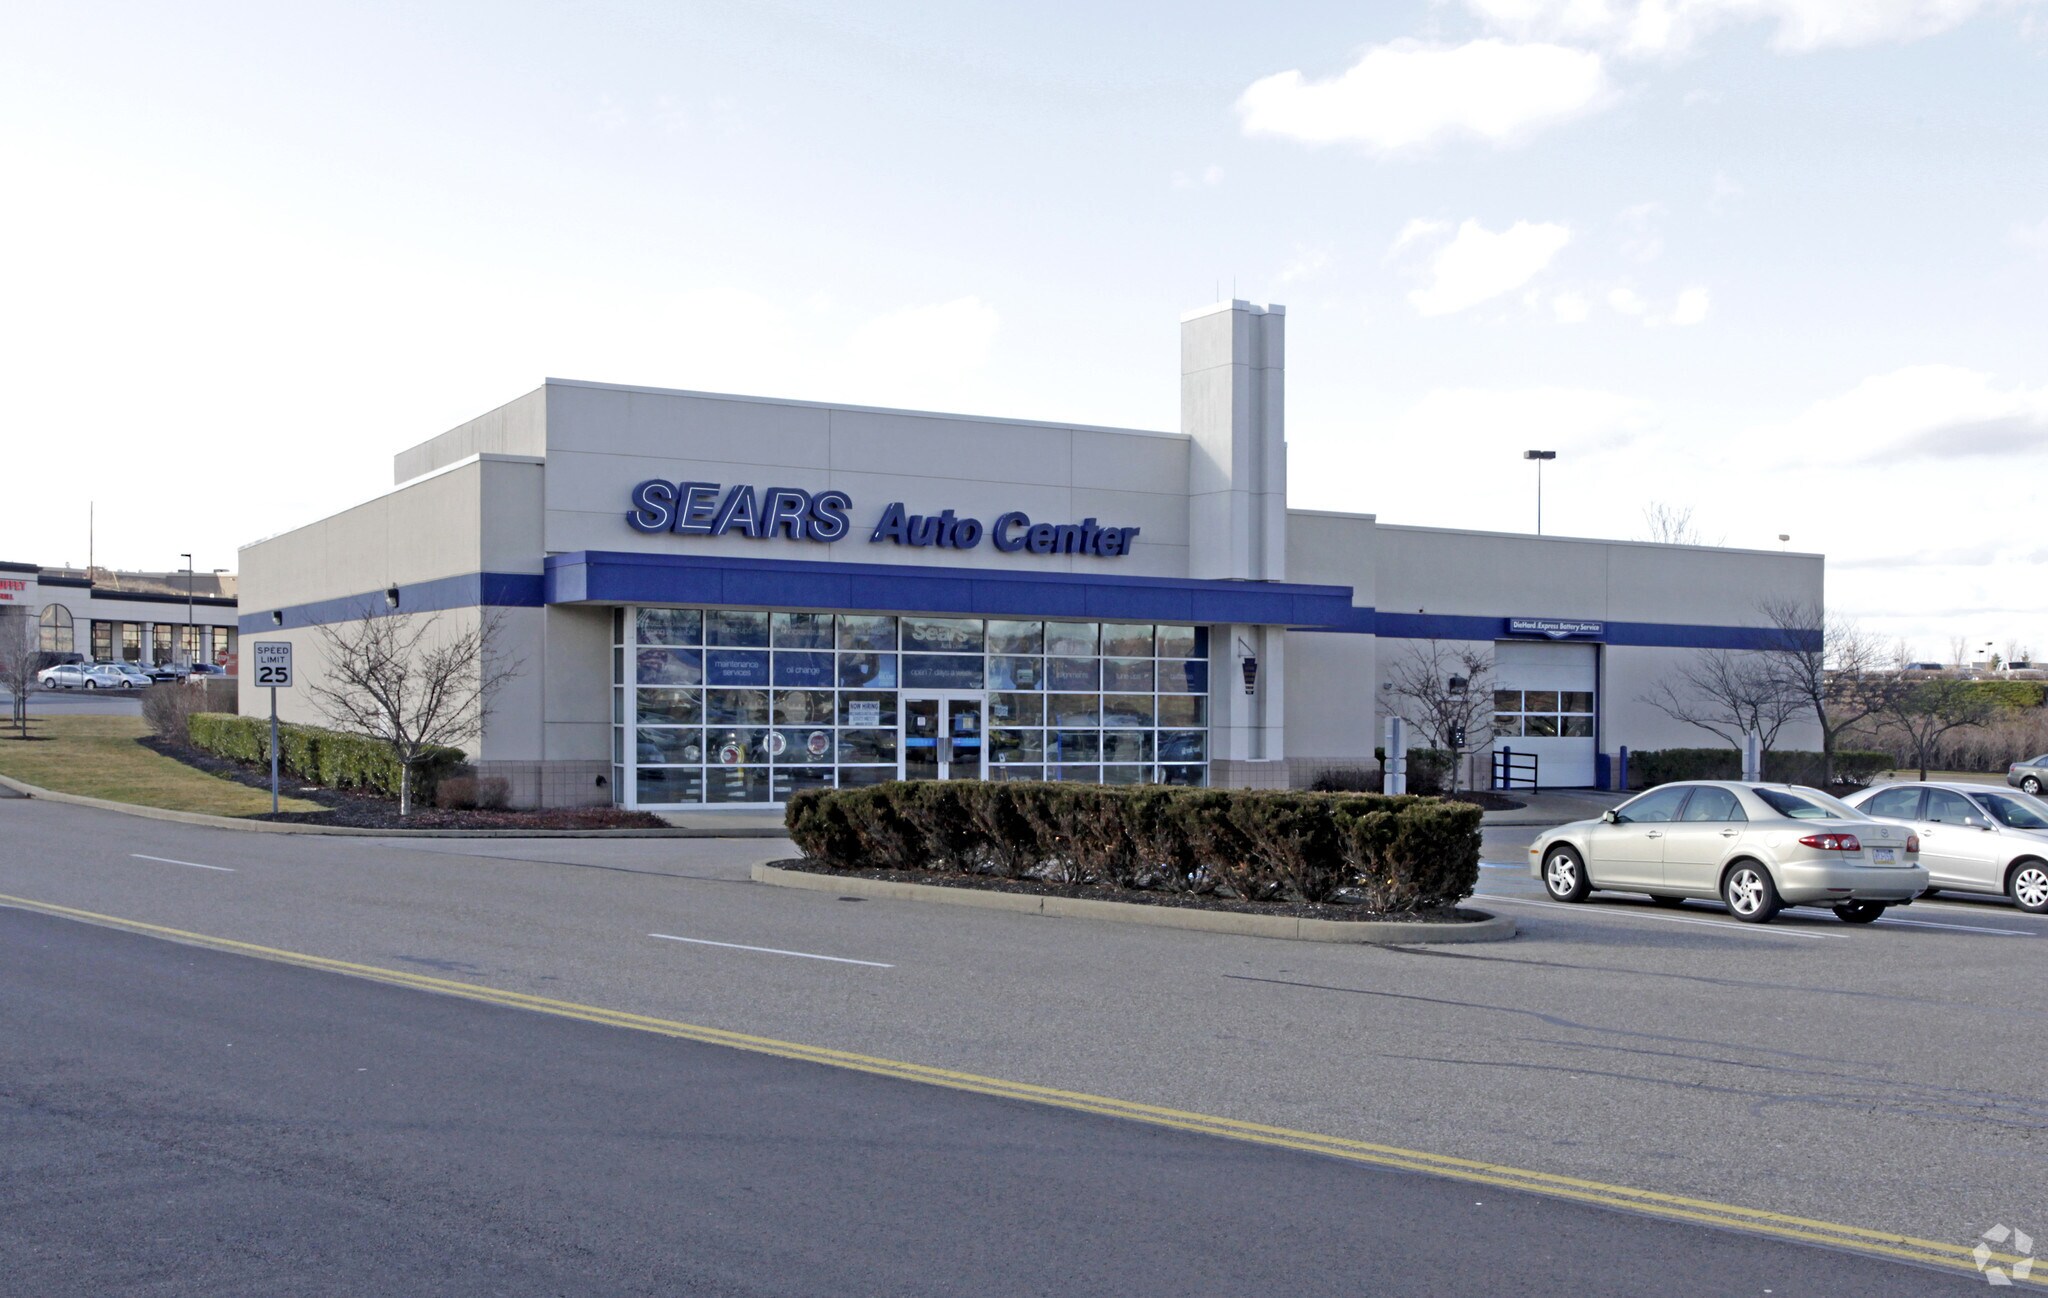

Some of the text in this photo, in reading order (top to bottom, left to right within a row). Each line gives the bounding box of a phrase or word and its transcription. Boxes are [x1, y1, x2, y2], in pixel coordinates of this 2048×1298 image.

[626, 478, 1141, 557] SEARS Auto Center
[1513, 621, 1600, 631] DieHard Express Battery Service
[257, 646, 289, 655] SPEED
[260, 656, 286, 664] LIMIT
[714, 659, 760, 669] maintenance
[259, 667, 288, 683] 25
[722, 668, 752, 677] services
[786, 666, 820, 676] oil change
